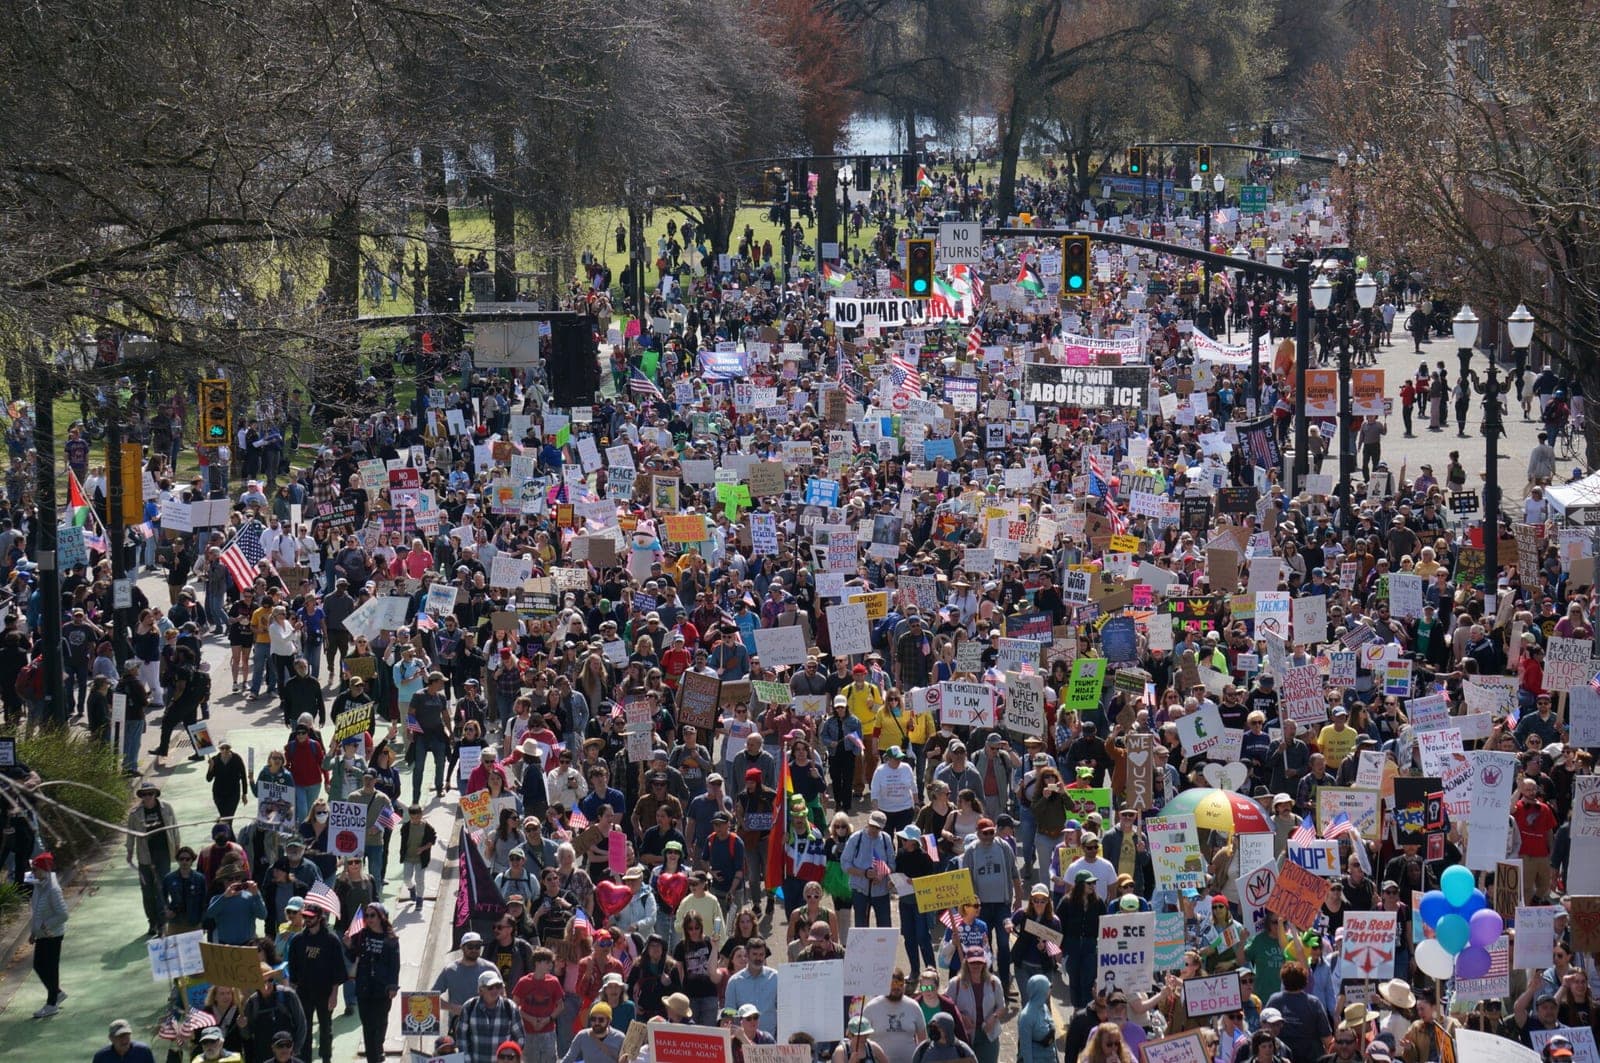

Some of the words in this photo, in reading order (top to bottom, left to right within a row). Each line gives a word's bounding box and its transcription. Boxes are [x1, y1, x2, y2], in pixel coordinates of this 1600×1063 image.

[953, 229, 968, 240] NO
[943, 247, 979, 258] TURNS
[836, 301, 857, 322] NO
[861, 301, 898, 322] WAR
[902, 299, 923, 320] ON
[1061, 368, 1084, 383] We
[1087, 370, 1113, 385] will
[1030, 383, 1105, 405] ABOLISH
[1113, 387, 1142, 406] ICE
[399, 472, 408, 480] NO
[1584, 511, 1600, 521] ONE
[831, 561, 853, 569] HELL
[1069, 570, 1084, 579] NO
[1067, 577, 1086, 591] WAR
[1264, 592, 1280, 600] LOVE
[1168, 601, 1184, 613] NO
[1180, 620, 1215, 631] KINGS
[1330, 652, 1355, 661] VOTE
[1283, 665, 1317, 681] GRAND
[1550, 662, 1585, 680] STOPS
[944, 683, 952, 693] THE
[954, 684, 989, 695] CONSTITUTION
[1284, 676, 1321, 691] PARENTS
[1008, 687, 1039, 702] NUREM
[1071, 693, 1095, 702] TOUCH
[1284, 687, 1323, 701] MARCHING
[954, 697, 961, 705] IS
[963, 697, 979, 707] LAW
[1013, 699, 1034, 712] BERG
[1289, 700, 1324, 715] AGAIN
[336, 704, 372, 729] PROTEST
[682, 712, 710, 725] HOME
[1008, 712, 1040, 728] COMING
[1129, 738, 1148, 749] WE
[1193, 735, 1219, 753] RESIST
[1477, 754, 1489, 765] NO
[1442, 762, 1471, 782] ORANGE
[1133, 767, 1146, 808] USA
[332, 802, 361, 815] DEAD
[1444, 800, 1470, 815] BUTTE
[330, 815, 366, 828] SERIOUS
[1147, 823, 1179, 832] GEORGE
[1165, 845, 1182, 853] DON
[1184, 844, 1199, 852] THE
[1160, 874, 1171, 882] NO
[1176, 873, 1198, 881] MORE
[1497, 864, 1518, 888] NO
[1346, 919, 1367, 930] The
[1369, 918, 1395, 930] Real
[1102, 926, 1118, 939] NO
[1123, 926, 1146, 938] ICE
[1345, 930, 1395, 943] Patriots
[1101, 951, 1145, 967] NOICE!
[1204, 977, 1229, 990] WE
[1190, 994, 1240, 1012] PEOPLE
[656, 1039, 677, 1047] MAKE
[680, 1041, 723, 1050] AUTOCRACY
[663, 1048, 691, 1056] GAUCHE
[696, 1050, 718, 1058] AGAIN
[1148, 1049, 1161, 1058] We
